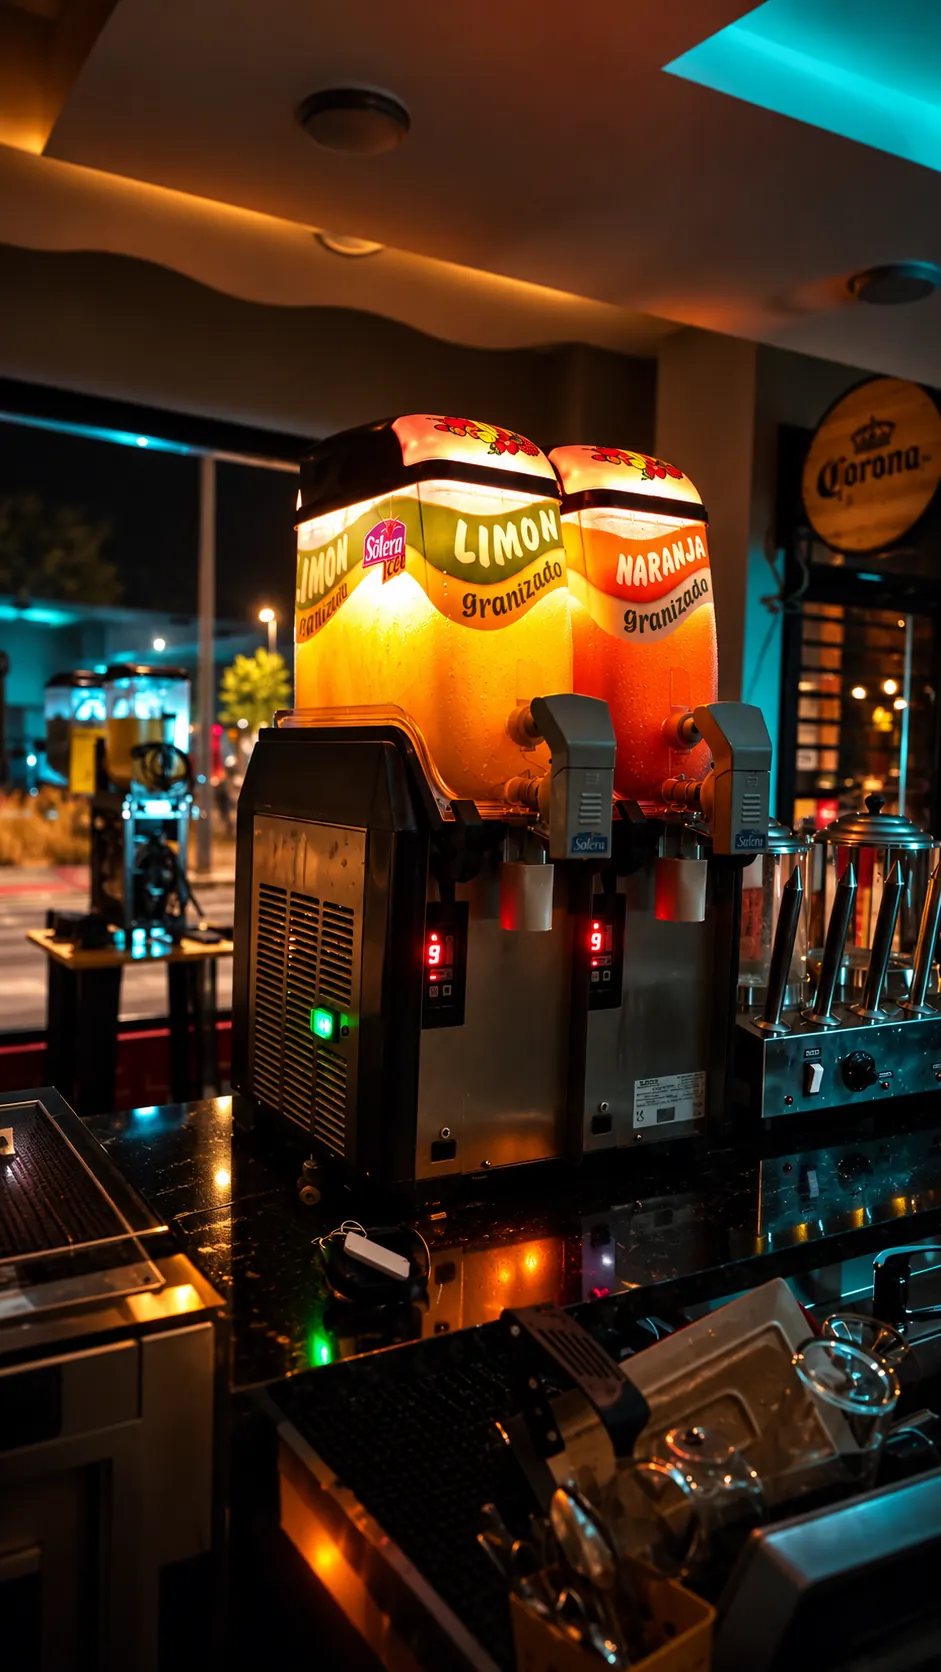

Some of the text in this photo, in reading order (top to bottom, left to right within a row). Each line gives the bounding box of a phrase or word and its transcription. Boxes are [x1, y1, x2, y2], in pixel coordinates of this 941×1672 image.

[817, 446, 919, 502] Corona
[454, 509, 559, 568] LIMON
[616, 535, 706, 587] NARANJA
[462, 560, 562, 618] granizado
[624, 578, 709, 633] granizado
[428, 945, 440, 964] 9
[591, 933, 602, 950] 9
